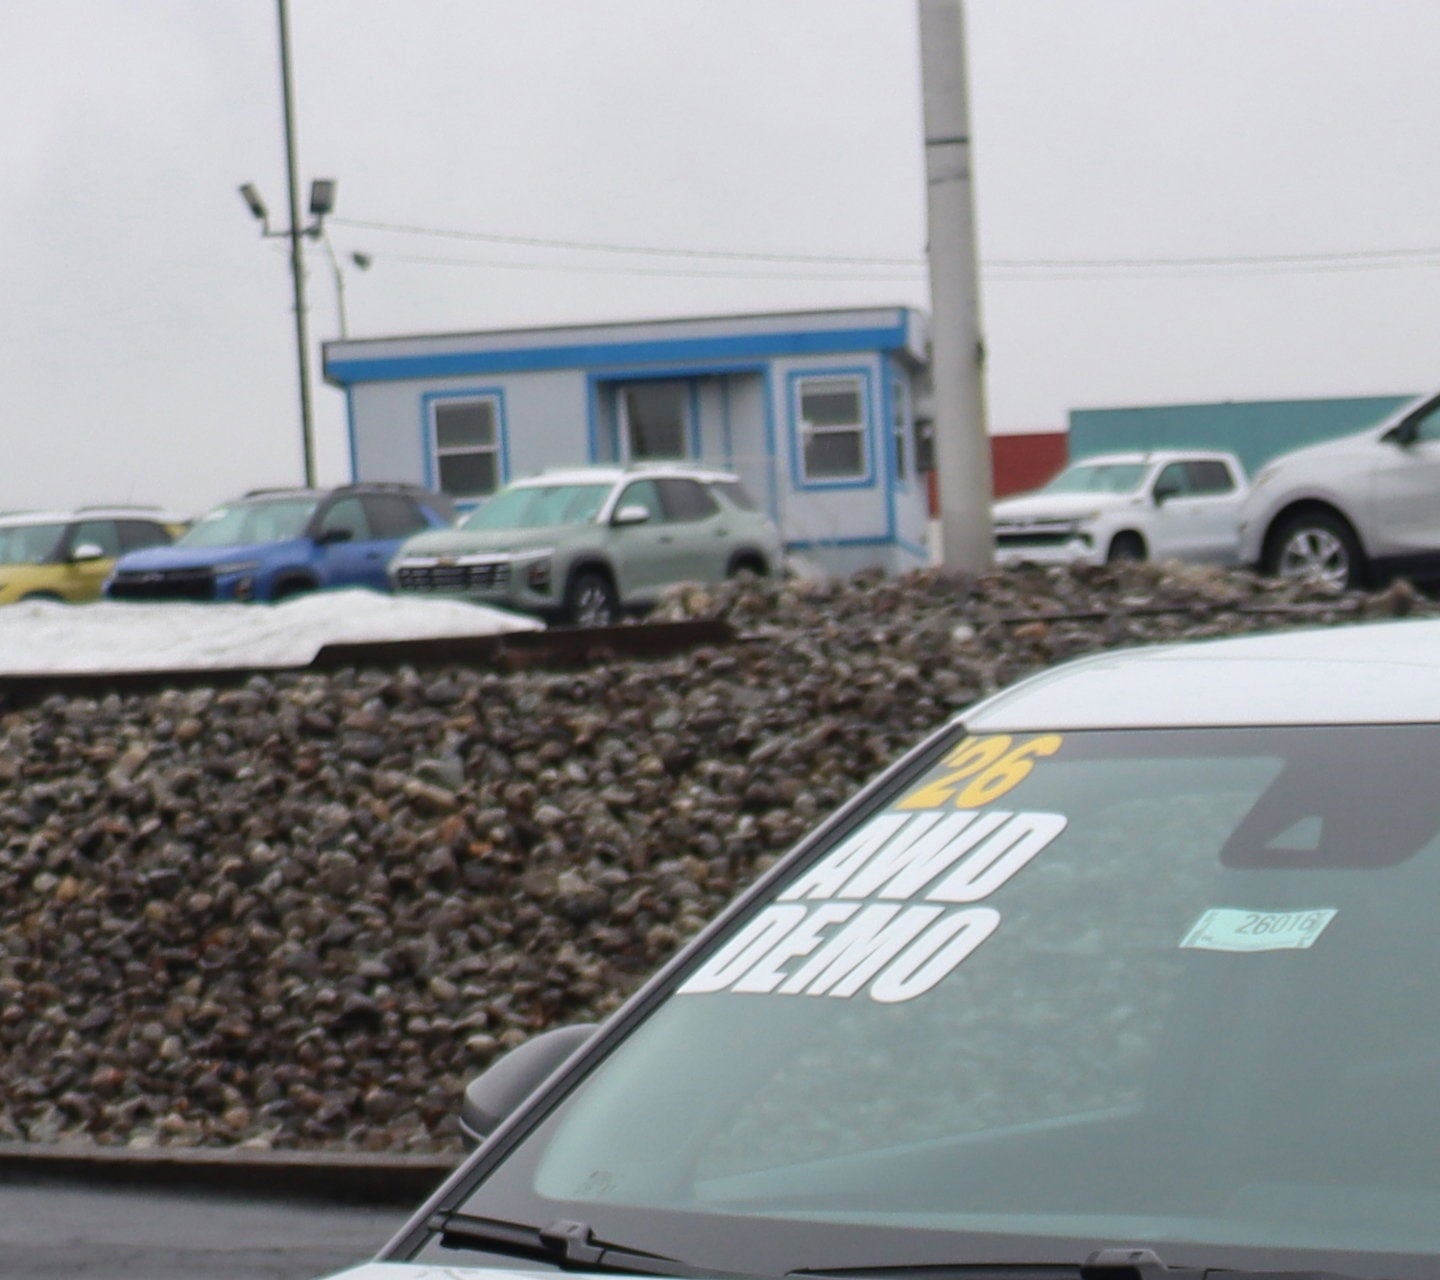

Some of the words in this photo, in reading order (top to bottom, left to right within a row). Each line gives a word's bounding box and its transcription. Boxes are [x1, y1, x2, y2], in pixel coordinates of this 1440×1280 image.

[897, 734, 1063, 810] '26
[775, 811, 1069, 903] AWD
[675, 904, 1002, 1004] DEMO
